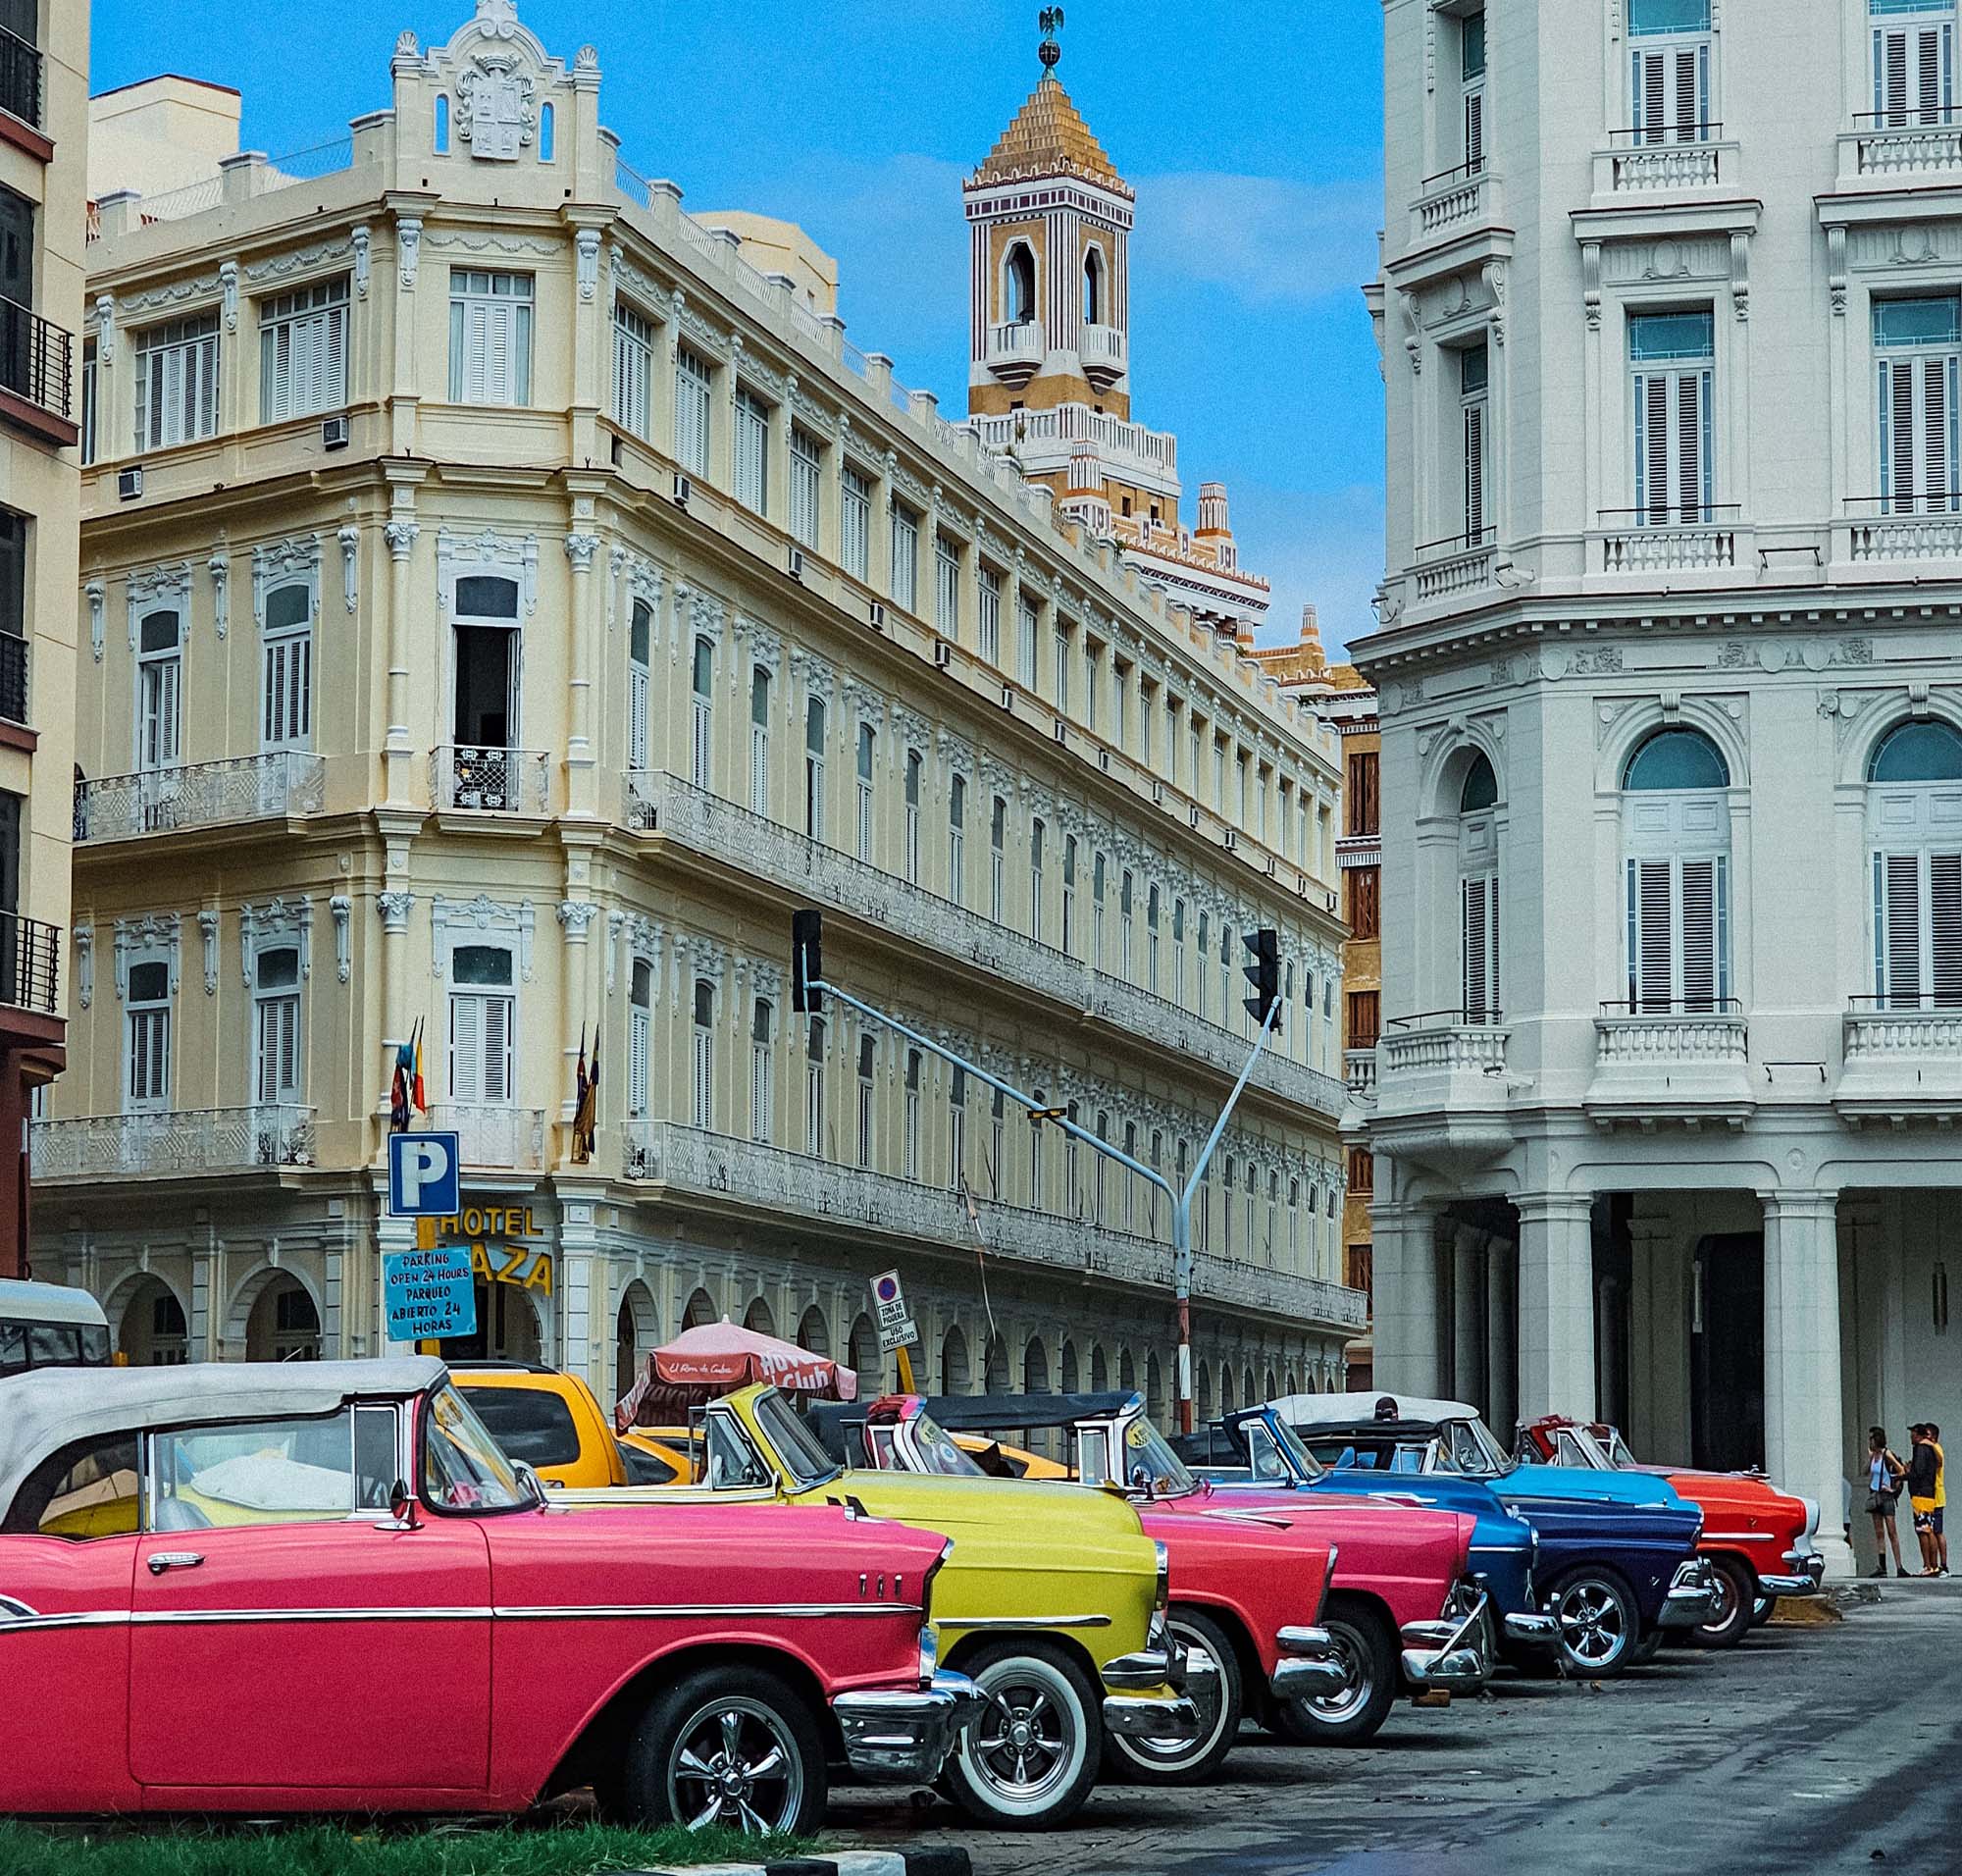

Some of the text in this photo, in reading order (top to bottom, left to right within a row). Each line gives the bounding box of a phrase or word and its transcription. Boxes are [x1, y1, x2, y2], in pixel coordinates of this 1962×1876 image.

[400, 1141, 448, 1208] P
[440, 1207, 543, 1236] HOTEL
[402, 1252, 449, 1268] PARKING
[390, 1268, 470, 1285] OPEN 24 HOURS
[470, 1241, 553, 1298] AZA
[406, 1286, 451, 1301] PARQUEO
[391, 1301, 461, 1321] ABIERTO 24
[896, 1302, 904, 1311] DE
[412, 1319, 452, 1334] HORAS
[890, 1326, 904, 1336] USO
[883, 1330, 915, 1347] EXCLUSIVO
[710, 1363, 733, 1374] Cuba
